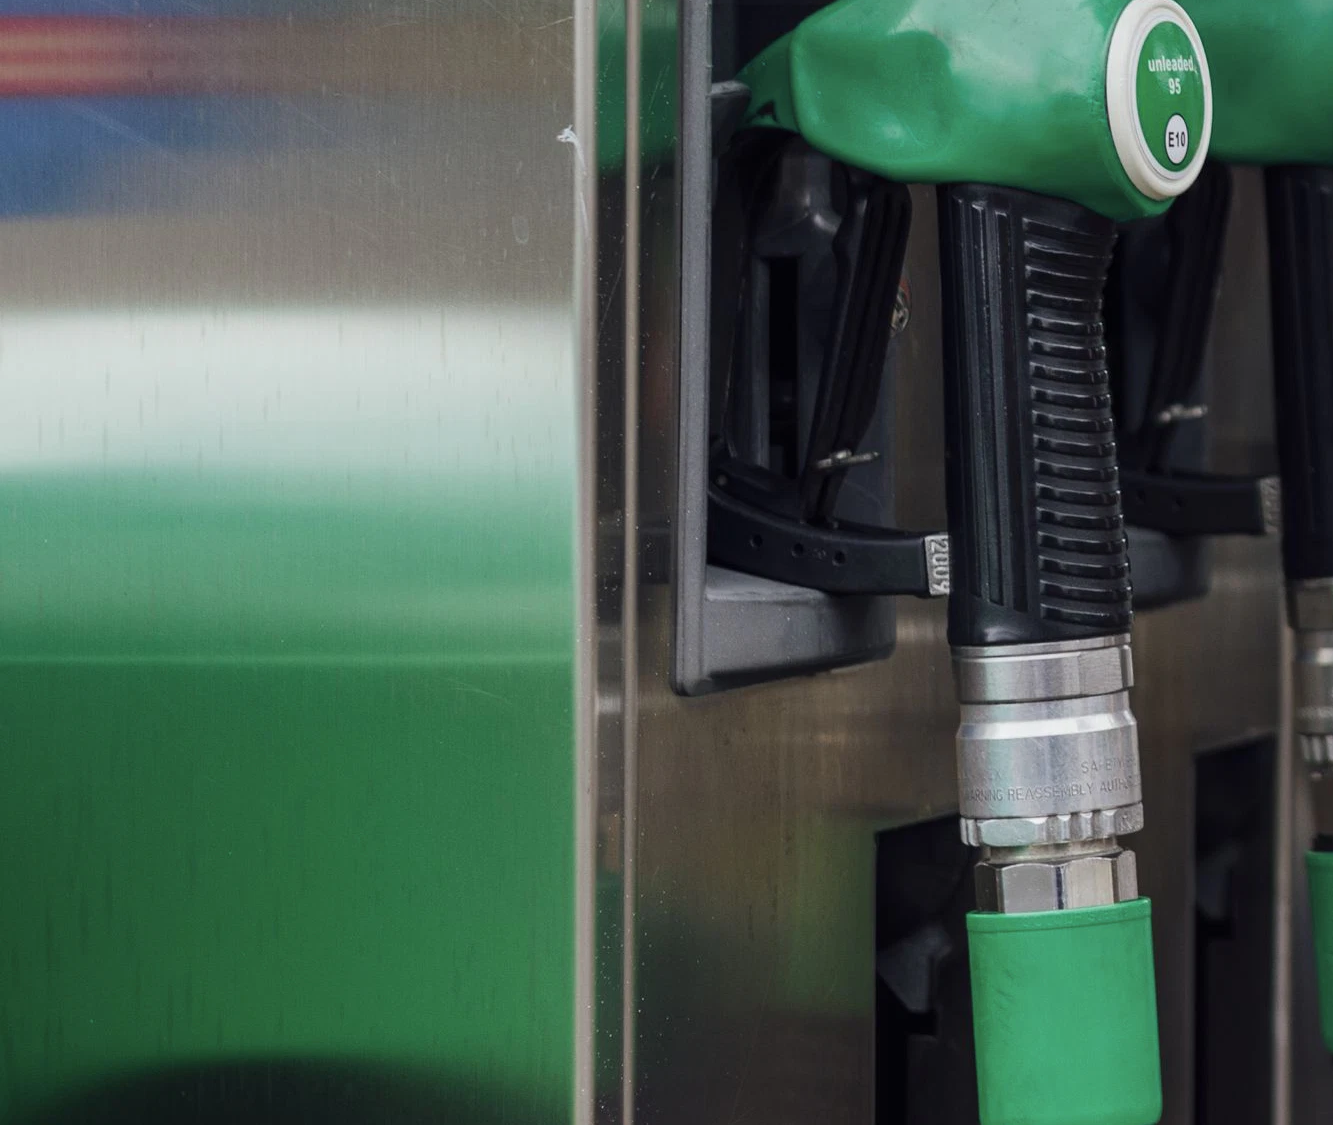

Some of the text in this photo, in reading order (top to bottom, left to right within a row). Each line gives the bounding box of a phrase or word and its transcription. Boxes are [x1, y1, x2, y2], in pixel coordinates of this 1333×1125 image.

[1148, 55, 1194, 72] unleaded
[1168, 78, 1182, 95] 95
[1168, 131, 1186, 148] E10
[931, 540, 950, 592] 2009
[964, 786, 1003, 803] ARNING
